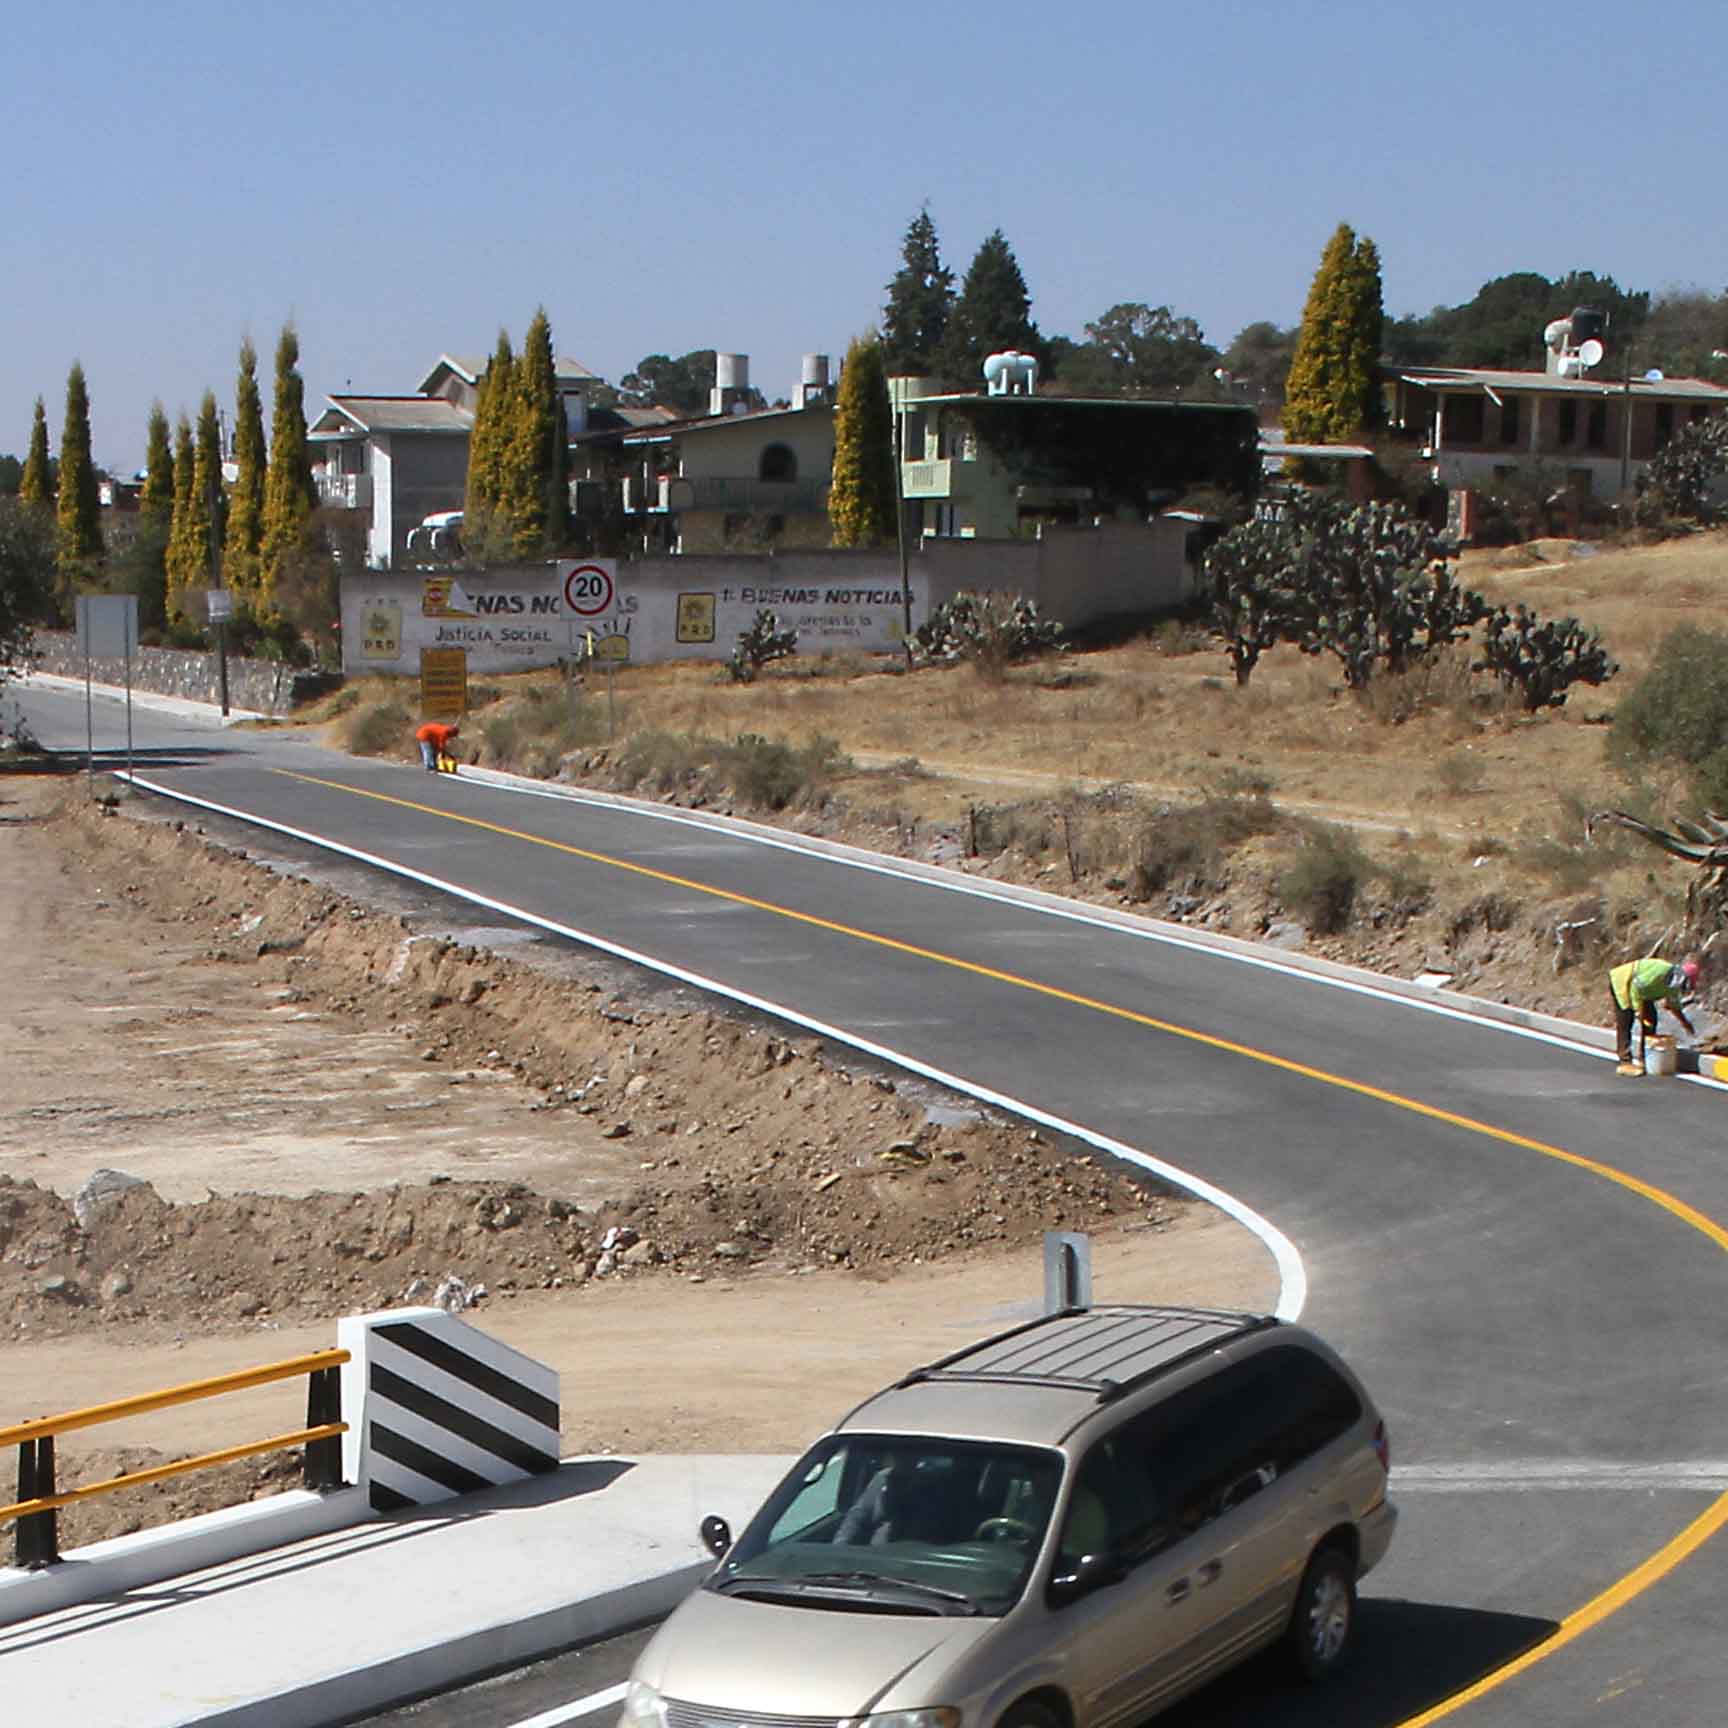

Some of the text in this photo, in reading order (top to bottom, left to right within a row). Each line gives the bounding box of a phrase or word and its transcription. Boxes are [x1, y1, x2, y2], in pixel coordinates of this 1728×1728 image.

[575, 576, 603, 598] 20
[741, 587, 819, 604] BUENAS
[467, 594, 525, 614] NAS
